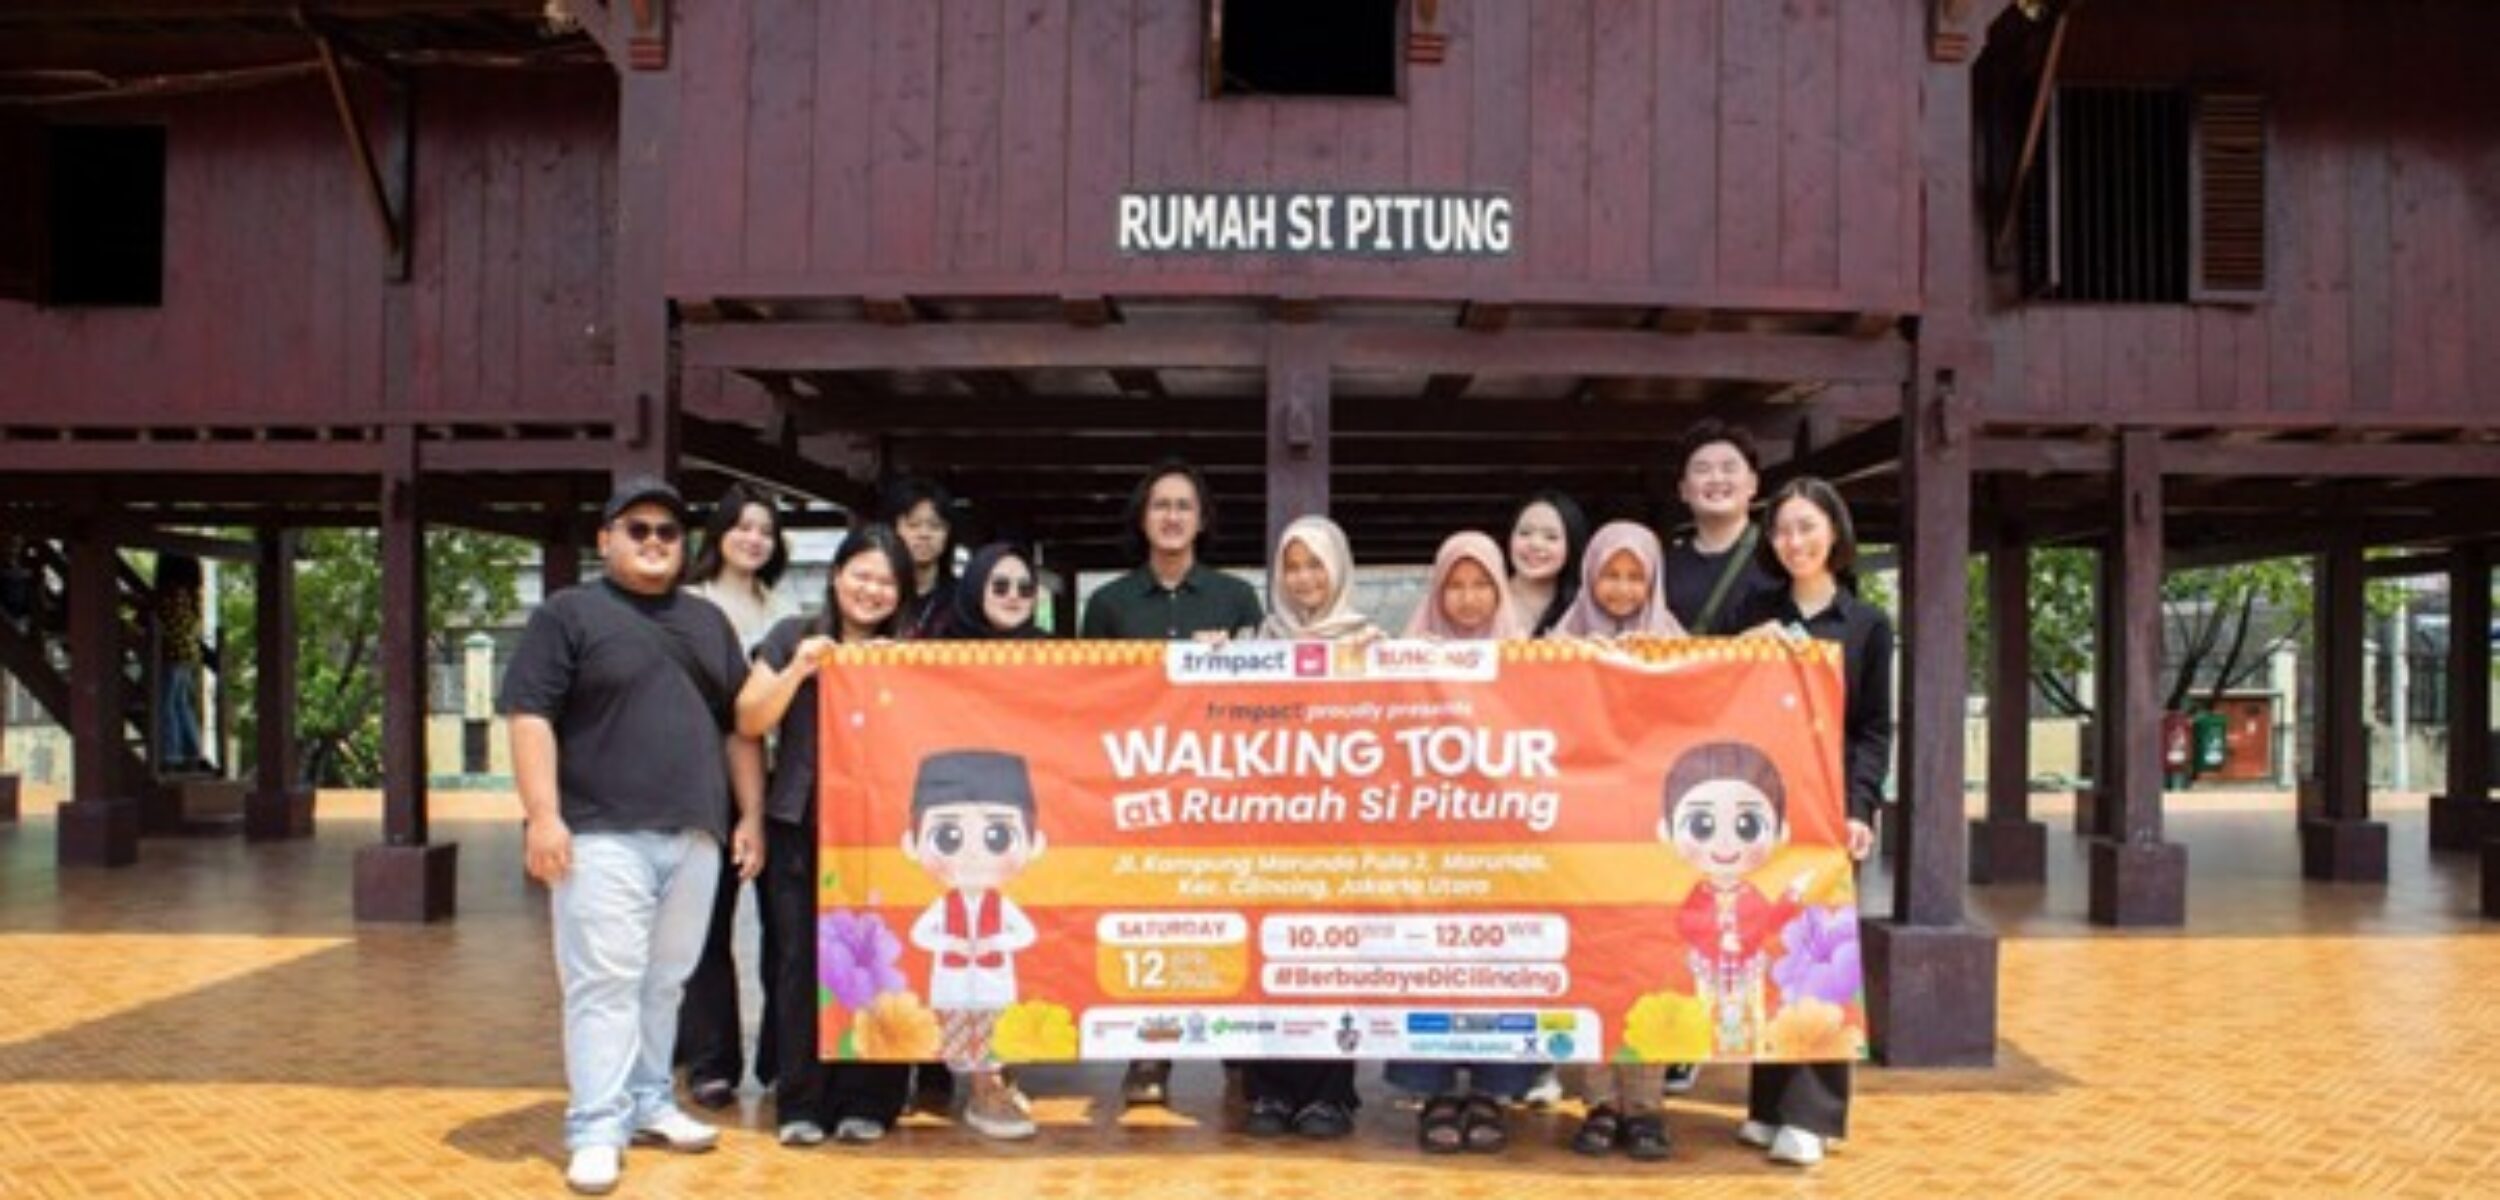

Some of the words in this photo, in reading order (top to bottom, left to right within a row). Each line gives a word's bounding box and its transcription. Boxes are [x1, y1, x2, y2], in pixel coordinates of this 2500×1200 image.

[1119, 195, 1276, 249] RUMAH
[1287, 196, 1334, 250] SI
[1347, 197, 1511, 251] PITUNG
[1103, 726, 1384, 780] WALKING
[1395, 726, 1559, 779] TOUR
[1120, 795, 1168, 826] at
[1180, 788, 1345, 823] Rumah
[1359, 783, 1398, 821] Si
[1409, 784, 1560, 831] Pitung
[1116, 920, 1227, 938] SATURDAY
[1121, 950, 1166, 988] 12
